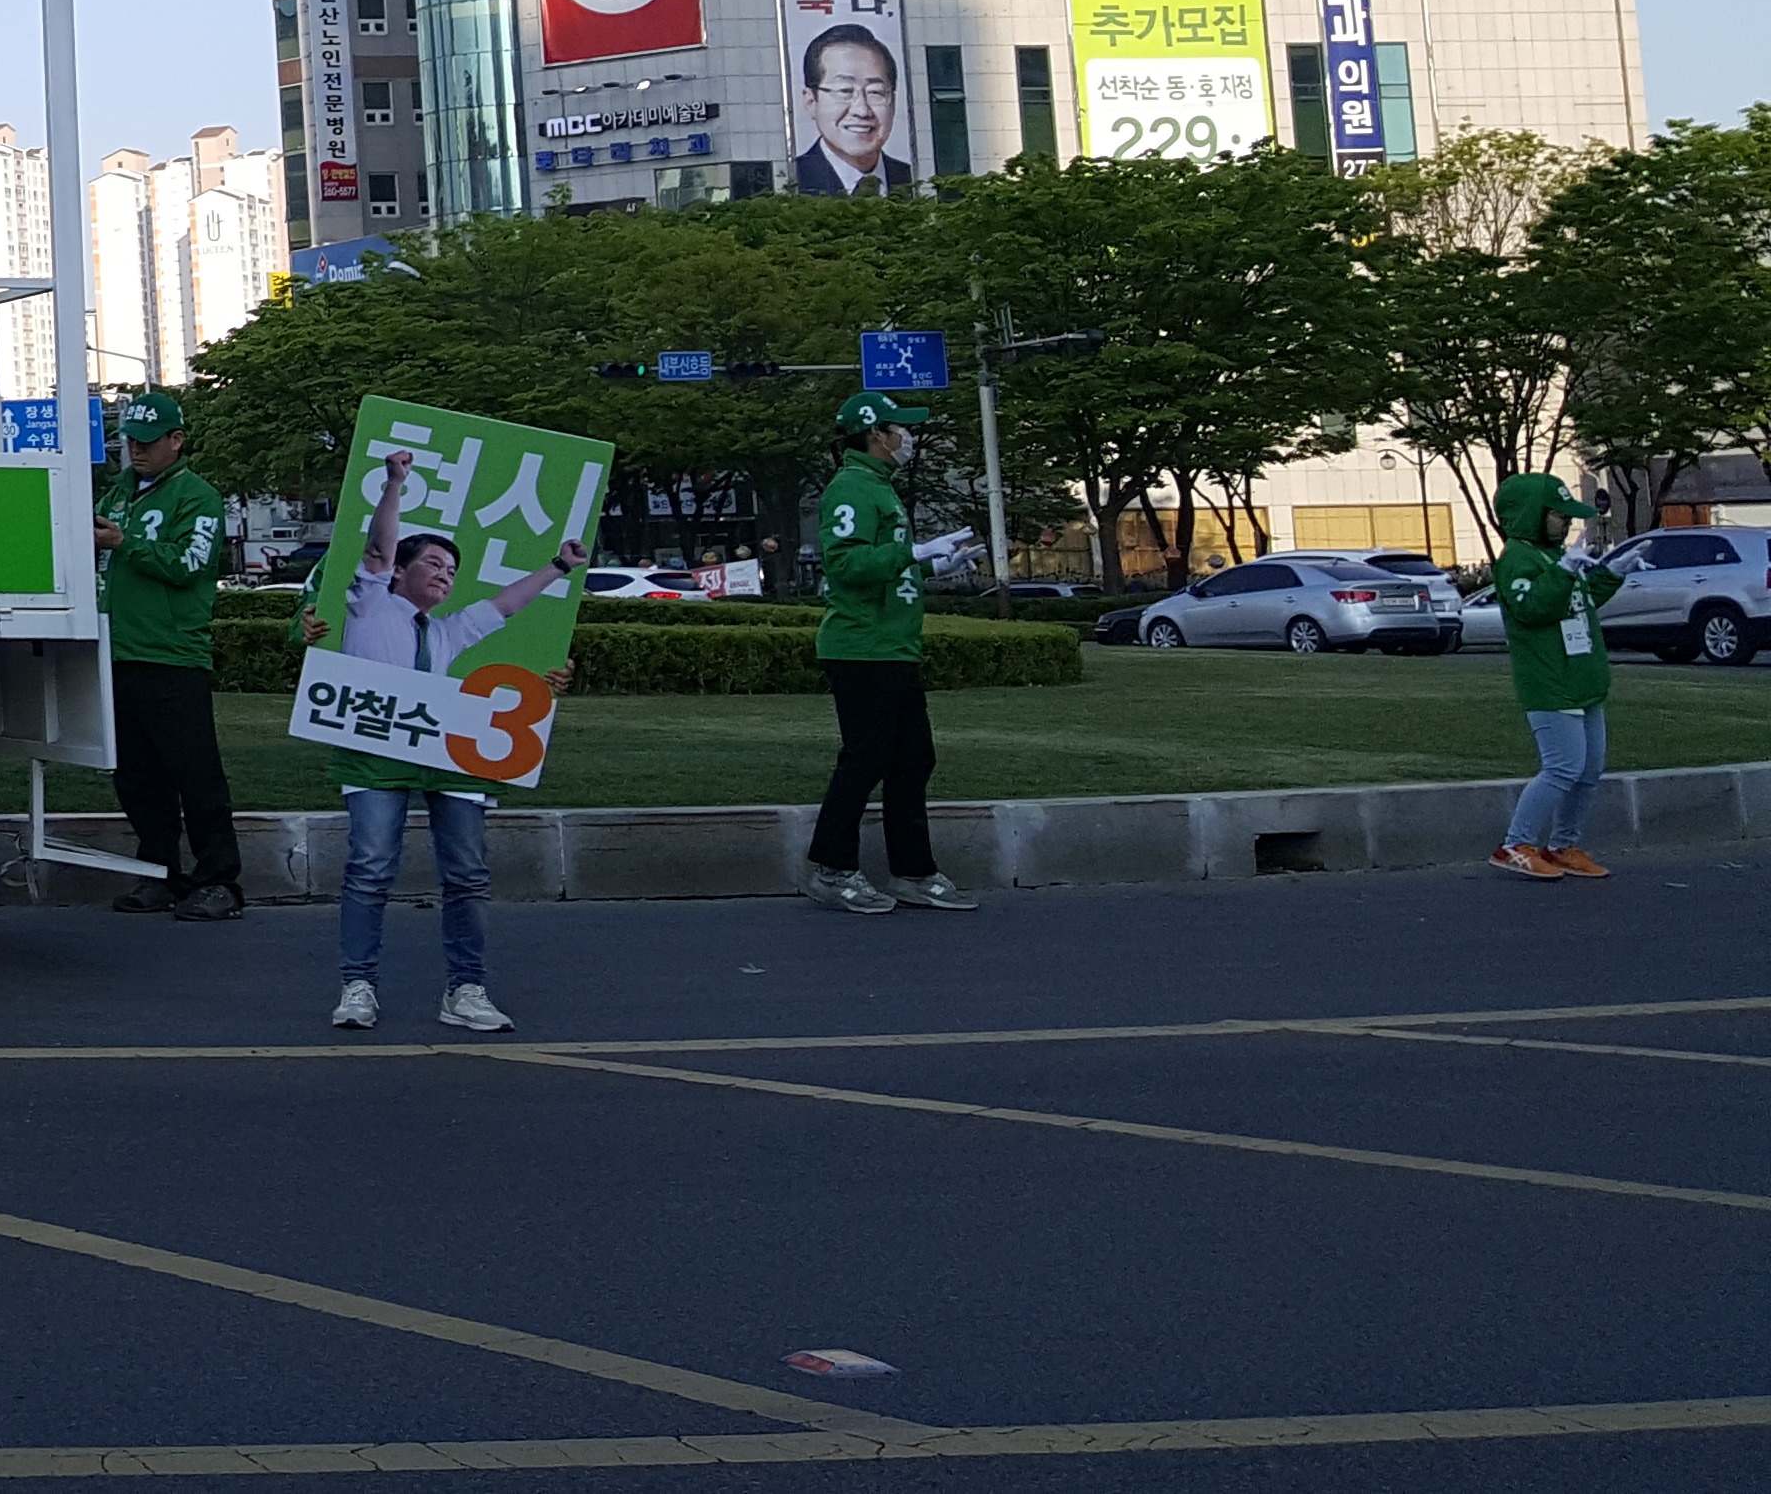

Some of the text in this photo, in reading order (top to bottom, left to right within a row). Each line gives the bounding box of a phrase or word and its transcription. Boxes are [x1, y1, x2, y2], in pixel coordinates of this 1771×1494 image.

[1089, 4, 1249, 47] 추가모집
[1097, 75, 1161, 101] 선착순
[1220, 74, 1253, 100] 지정
[1343, 159, 1377, 180] 27
[660, 356, 710, 377] 내부신호등
[25, 406, 58, 419] 장생
[859, 405, 877, 425] 3
[3, 424, 16, 436] 30
[25, 419, 57, 429] Jangsa
[27, 433, 55, 447] 수암
[360, 420, 604, 599] 혁신
[832, 504, 857, 538] 3
[307, 663, 554, 781] 안철수 3
